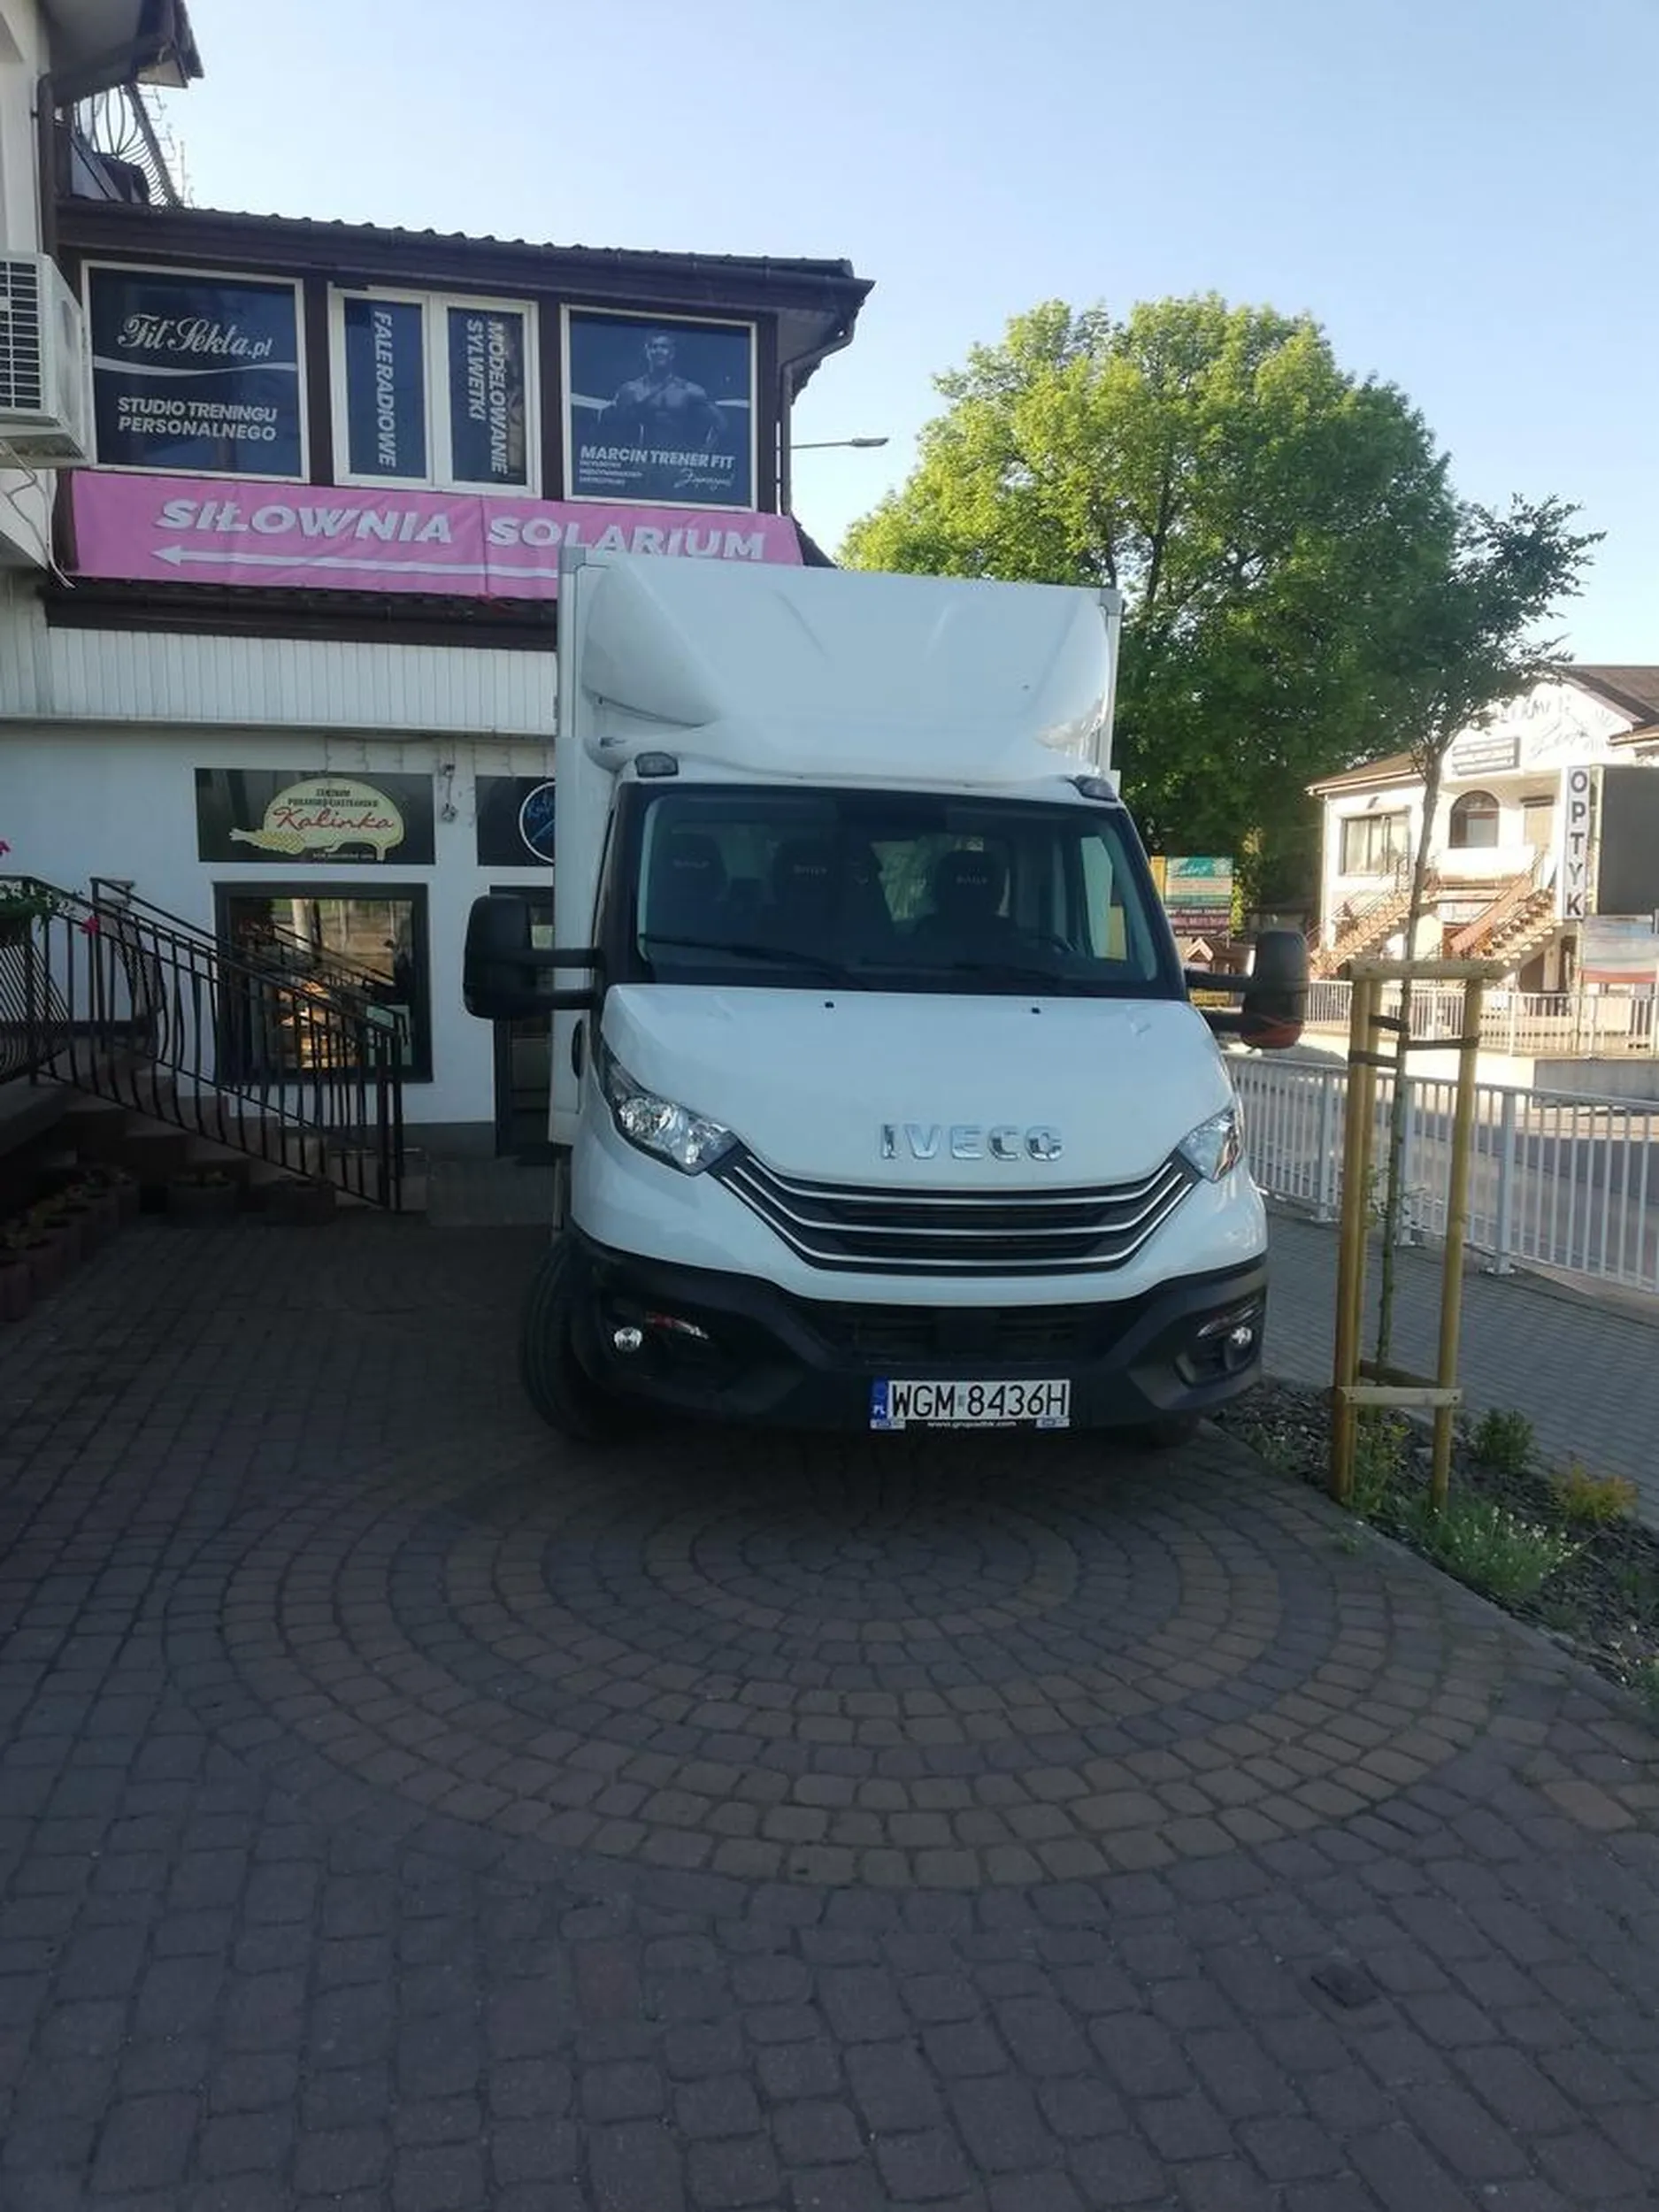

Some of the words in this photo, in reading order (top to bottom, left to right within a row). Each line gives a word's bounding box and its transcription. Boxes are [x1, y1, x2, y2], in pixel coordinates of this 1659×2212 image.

[467, 319, 486, 421] SYLWETKI
[118, 396, 186, 417] STUDIO
[187, 401, 278, 422] TRENINGU
[488, 320, 508, 475] MODELOWANIE
[118, 415, 277, 441] PERSONALNEGO
[580, 444, 648, 464] MARCIN
[649, 449, 708, 468] TRENER
[710, 454, 735, 470] FIT
[155, 498, 452, 543] SIŁOWNIA
[488, 516, 765, 560] SOLARIUM
[273, 806, 396, 831] Kalinka
[1566, 770, 1587, 917] OPTYK
[879, 1123, 1064, 1162] IVECO
[892, 1384, 956, 1417] WGM
[967, 1383, 1066, 1417] 8436H
